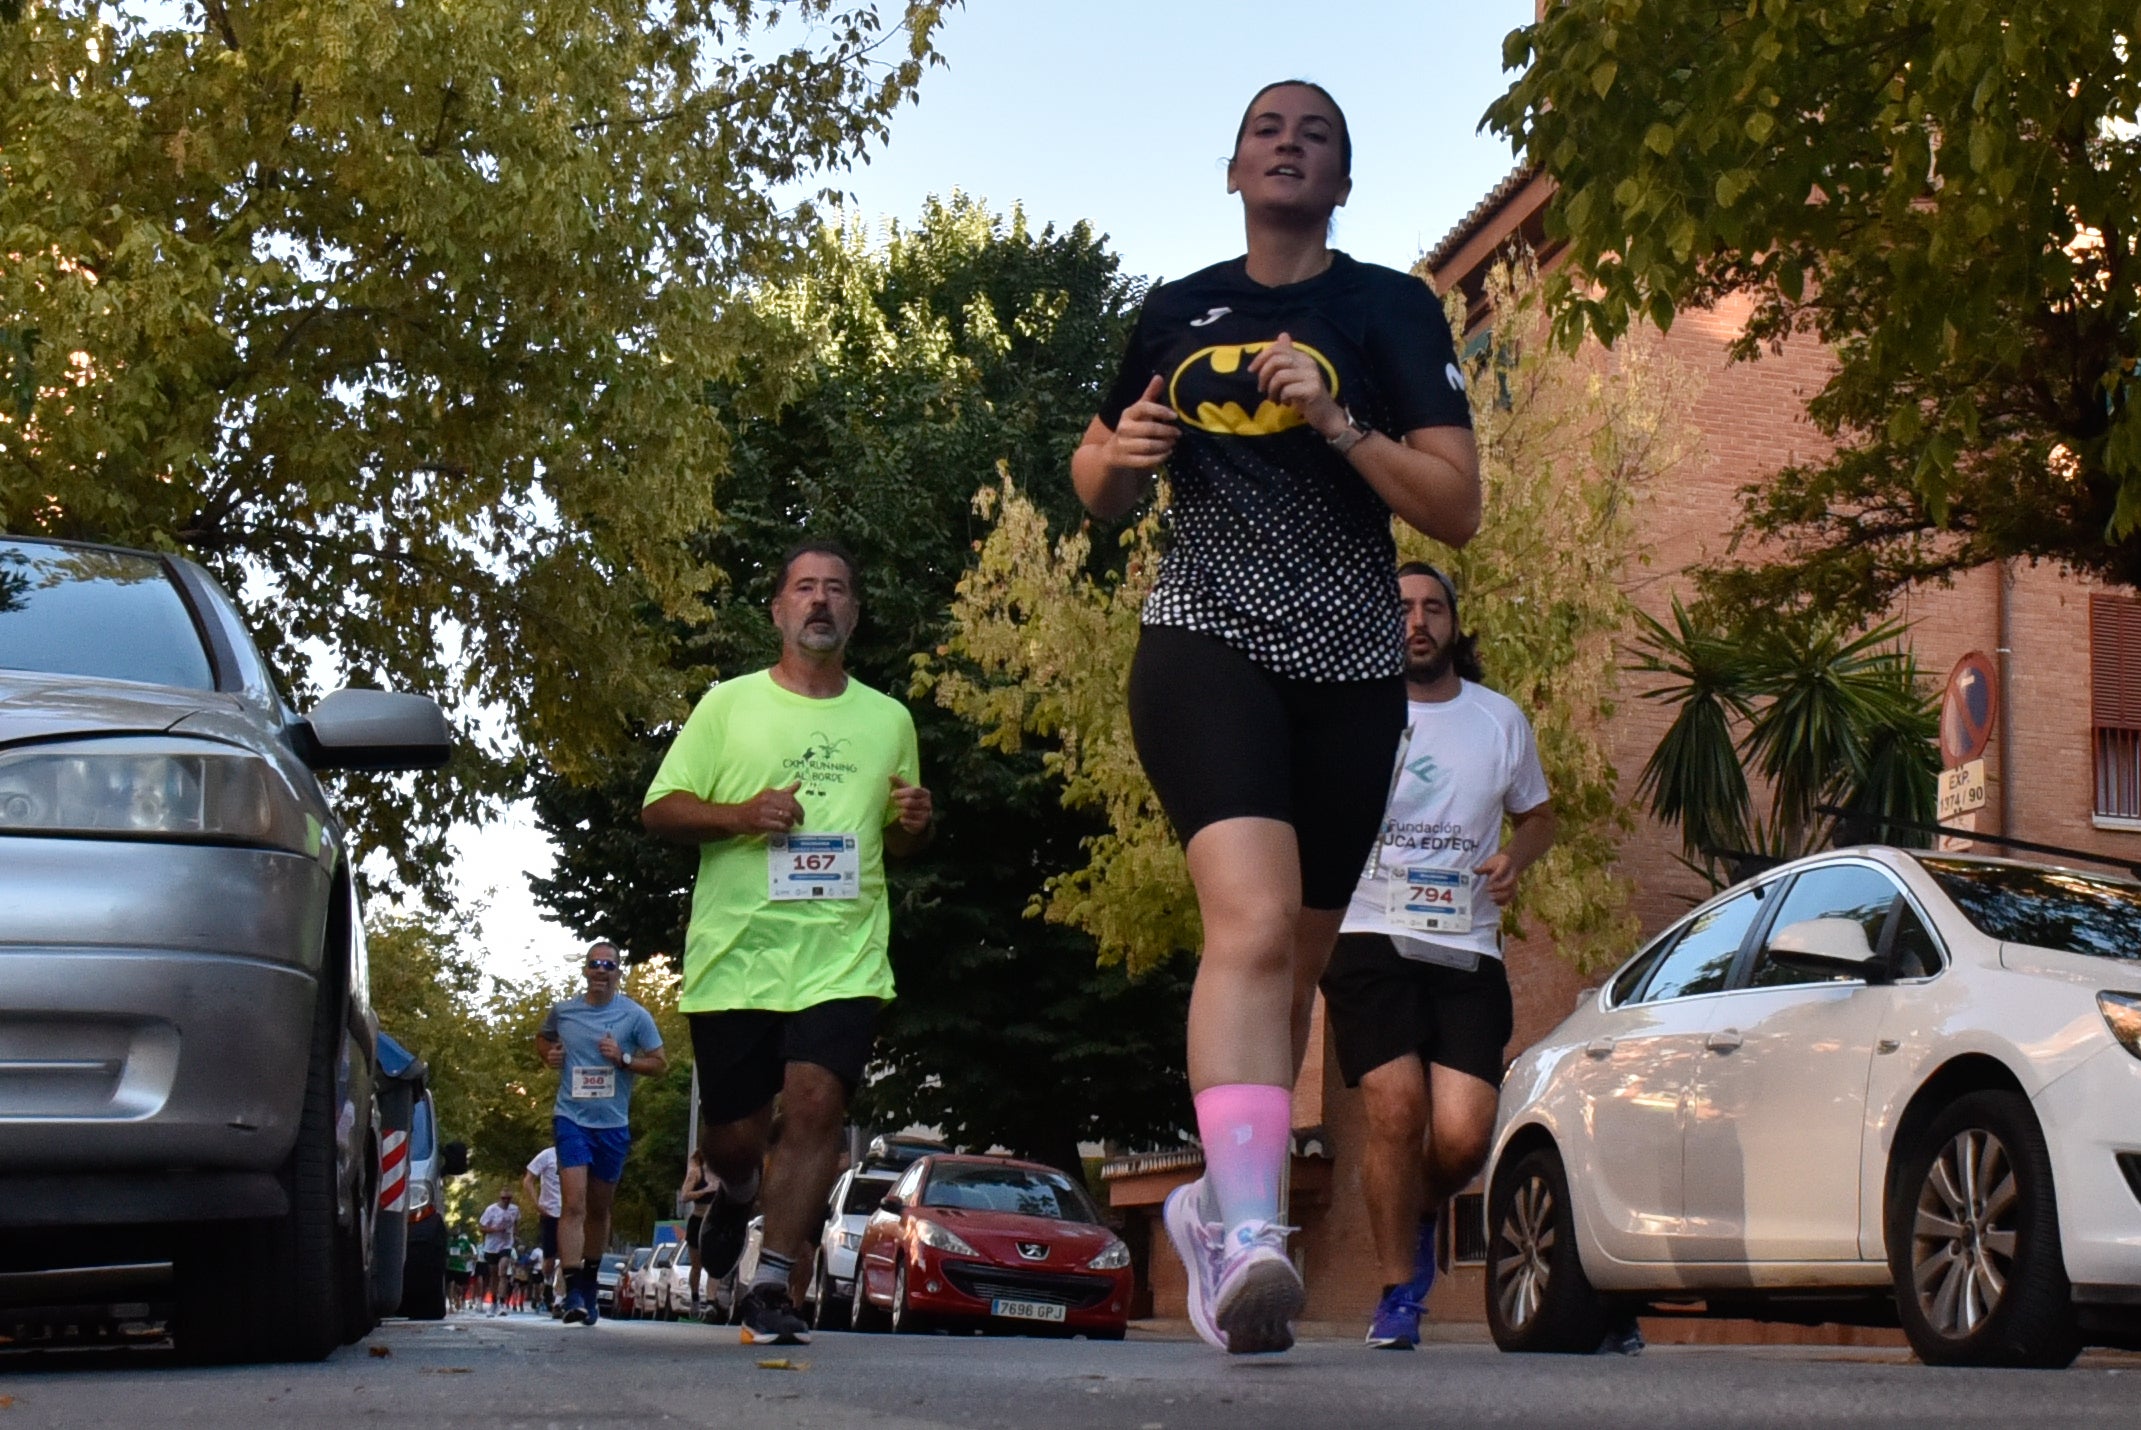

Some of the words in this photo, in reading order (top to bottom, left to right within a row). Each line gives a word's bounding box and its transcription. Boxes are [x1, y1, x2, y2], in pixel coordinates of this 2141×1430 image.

[809, 760, 858, 773] RUNNING
[794, 771, 806, 780] AL
[812, 772, 844, 783] BORDE
[1949, 770, 1970, 790] EXP.
[1388, 818, 1462, 834] Fundación
[793, 854, 836, 871] 167
[1409, 886, 1454, 904] 794
[1037, 1305, 1063, 1320] GPJ
